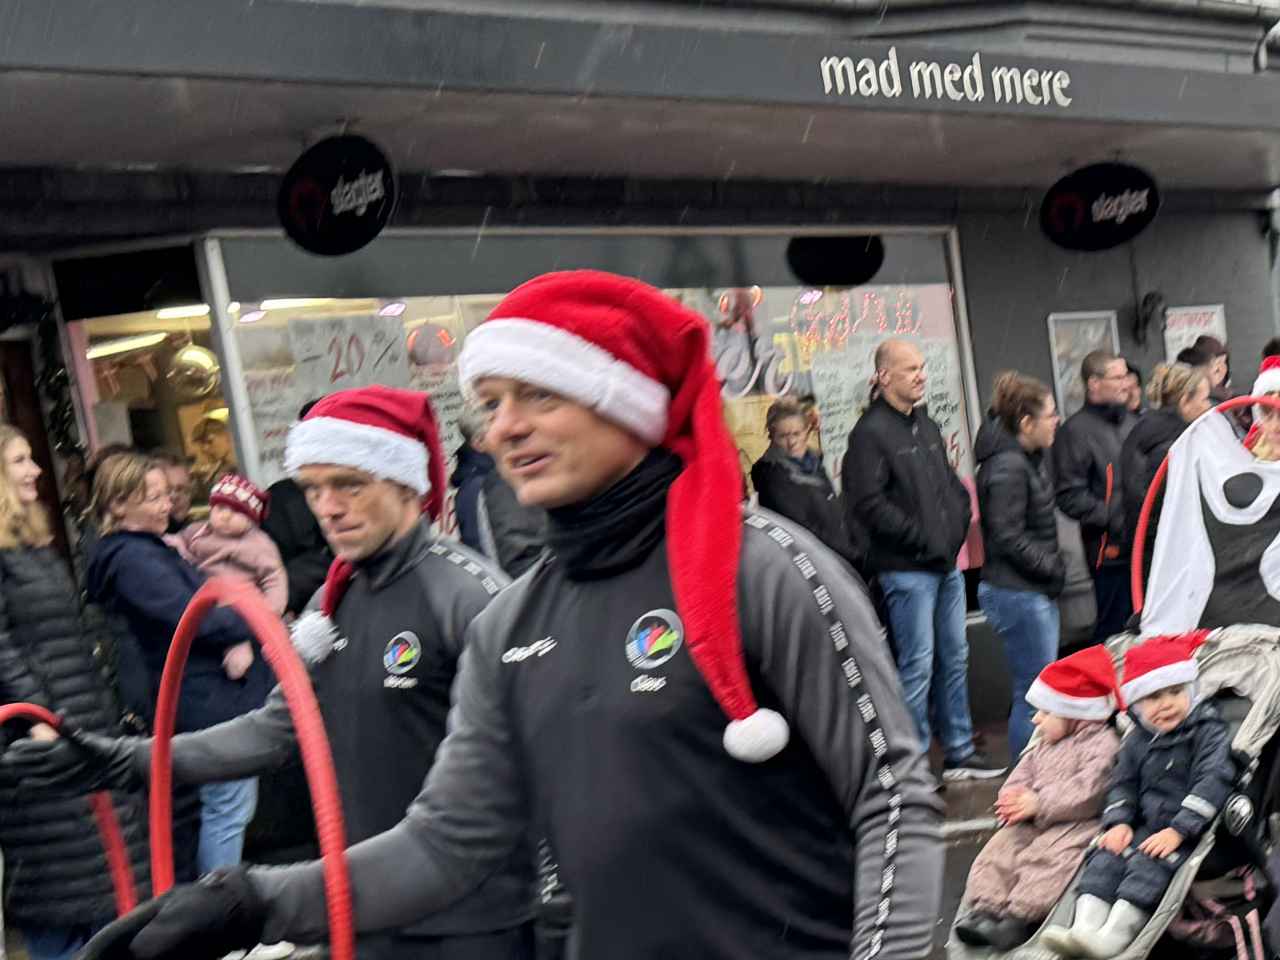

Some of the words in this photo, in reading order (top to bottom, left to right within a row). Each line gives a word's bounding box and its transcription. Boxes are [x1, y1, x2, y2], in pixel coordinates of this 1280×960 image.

[820, 46, 902, 98] mad
[909, 51, 985, 102] med
[991, 66, 1073, 107] mere
